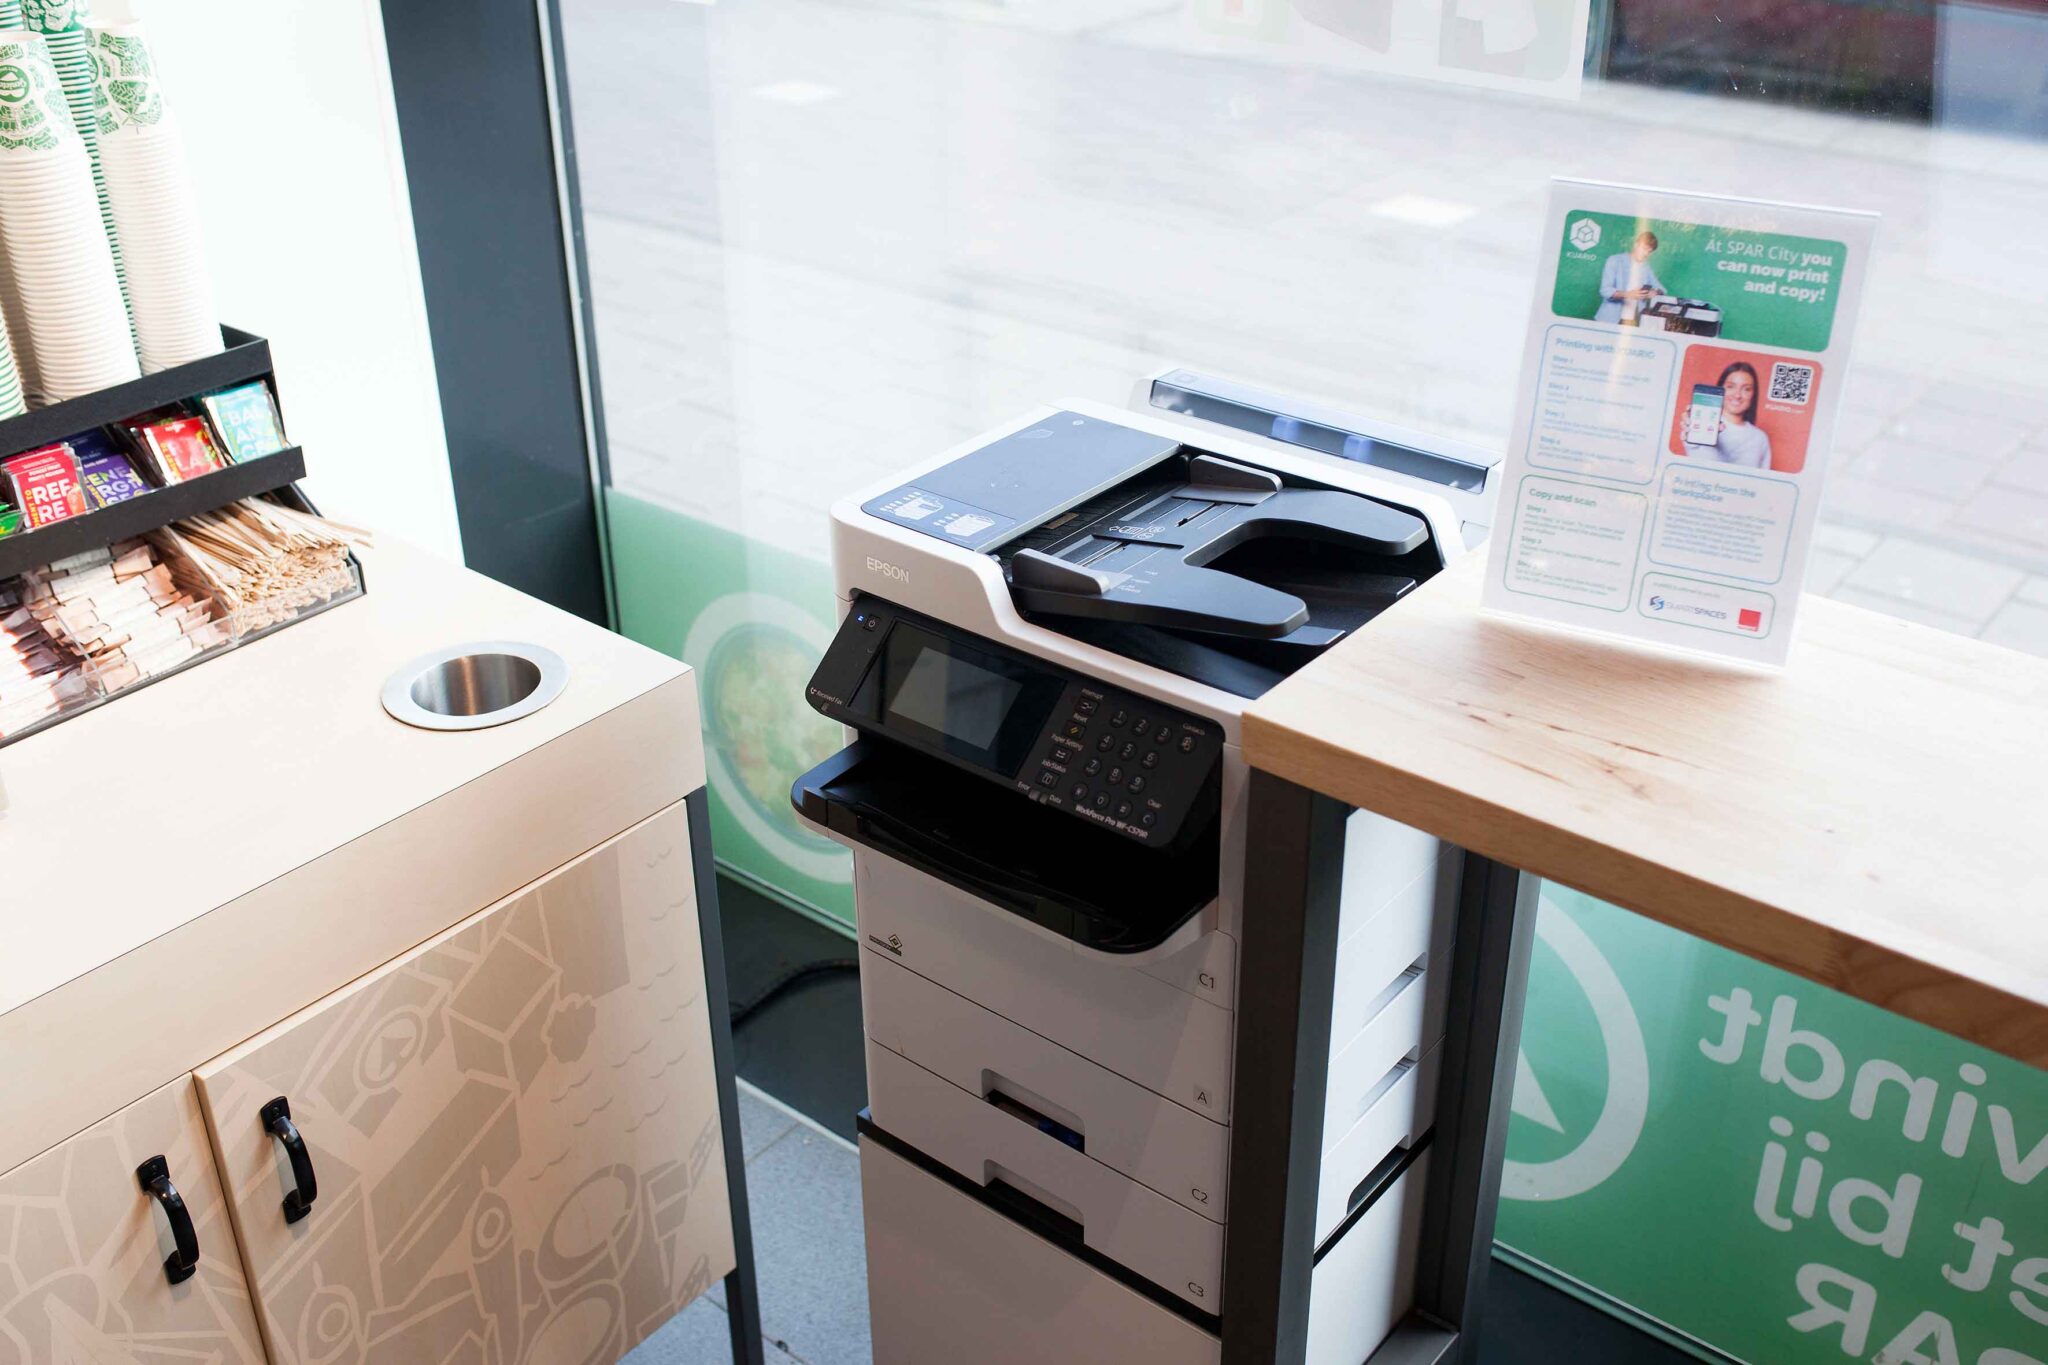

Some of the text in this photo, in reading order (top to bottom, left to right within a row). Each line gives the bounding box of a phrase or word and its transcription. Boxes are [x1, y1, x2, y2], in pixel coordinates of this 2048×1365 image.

[1705, 240, 1833, 267] At SPAR City you
[1717, 260, 1829, 283] can now print
[1744, 280, 1826, 303] and copy!
[1555, 337, 1593, 352] Printing
[32, 478, 72, 505] REF
[1529, 488, 1597, 507] Copy and scan
[37, 500, 68, 524] RE
[866, 556, 909, 584] EPSON
[1104, 815, 1116, 826] Pro
[1199, 972, 1215, 989] C1
[1197, 1091, 1208, 1105] A
[1191, 1188, 1208, 1205] C2
[1187, 1281, 1205, 1298] C3
